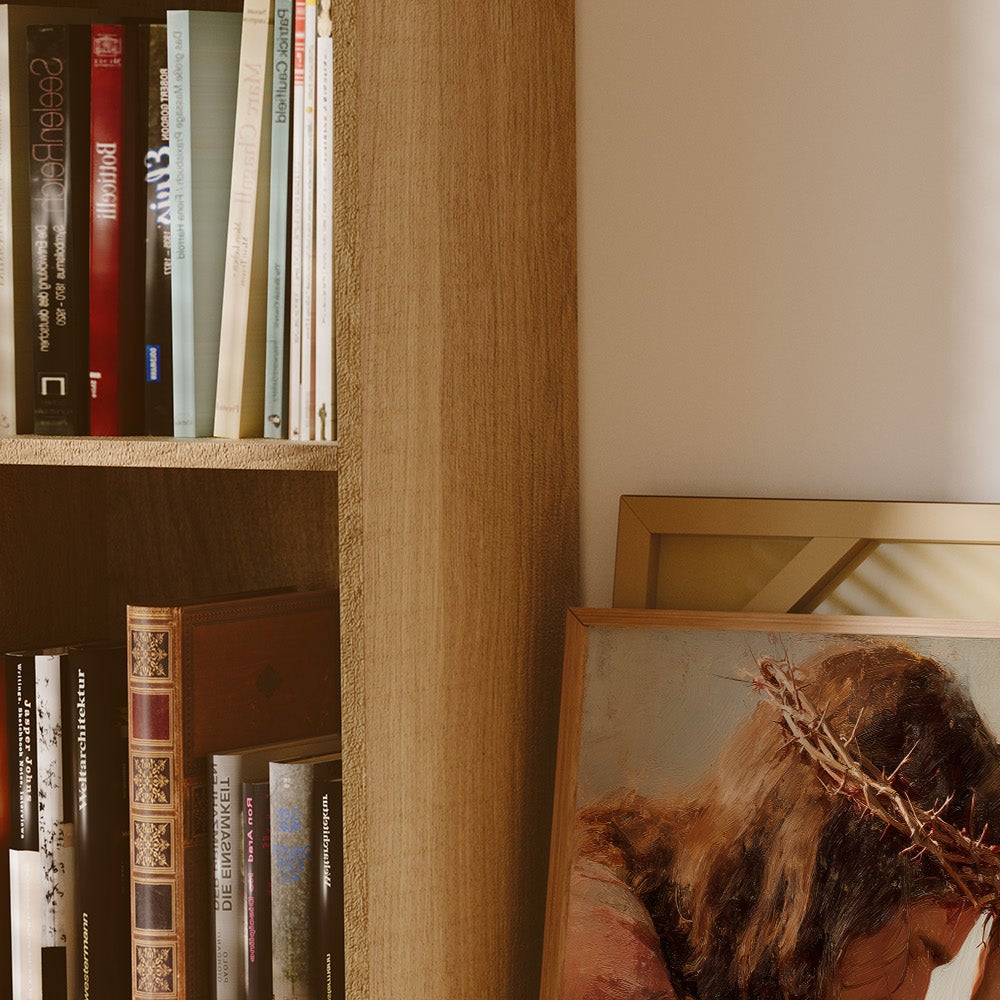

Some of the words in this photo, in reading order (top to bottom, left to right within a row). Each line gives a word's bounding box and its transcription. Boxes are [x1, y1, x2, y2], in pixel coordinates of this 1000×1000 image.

[23, 699, 33, 754] Jasper
[77, 668, 88, 812] Weltarchitektur
[23, 755, 34, 803] Johns
